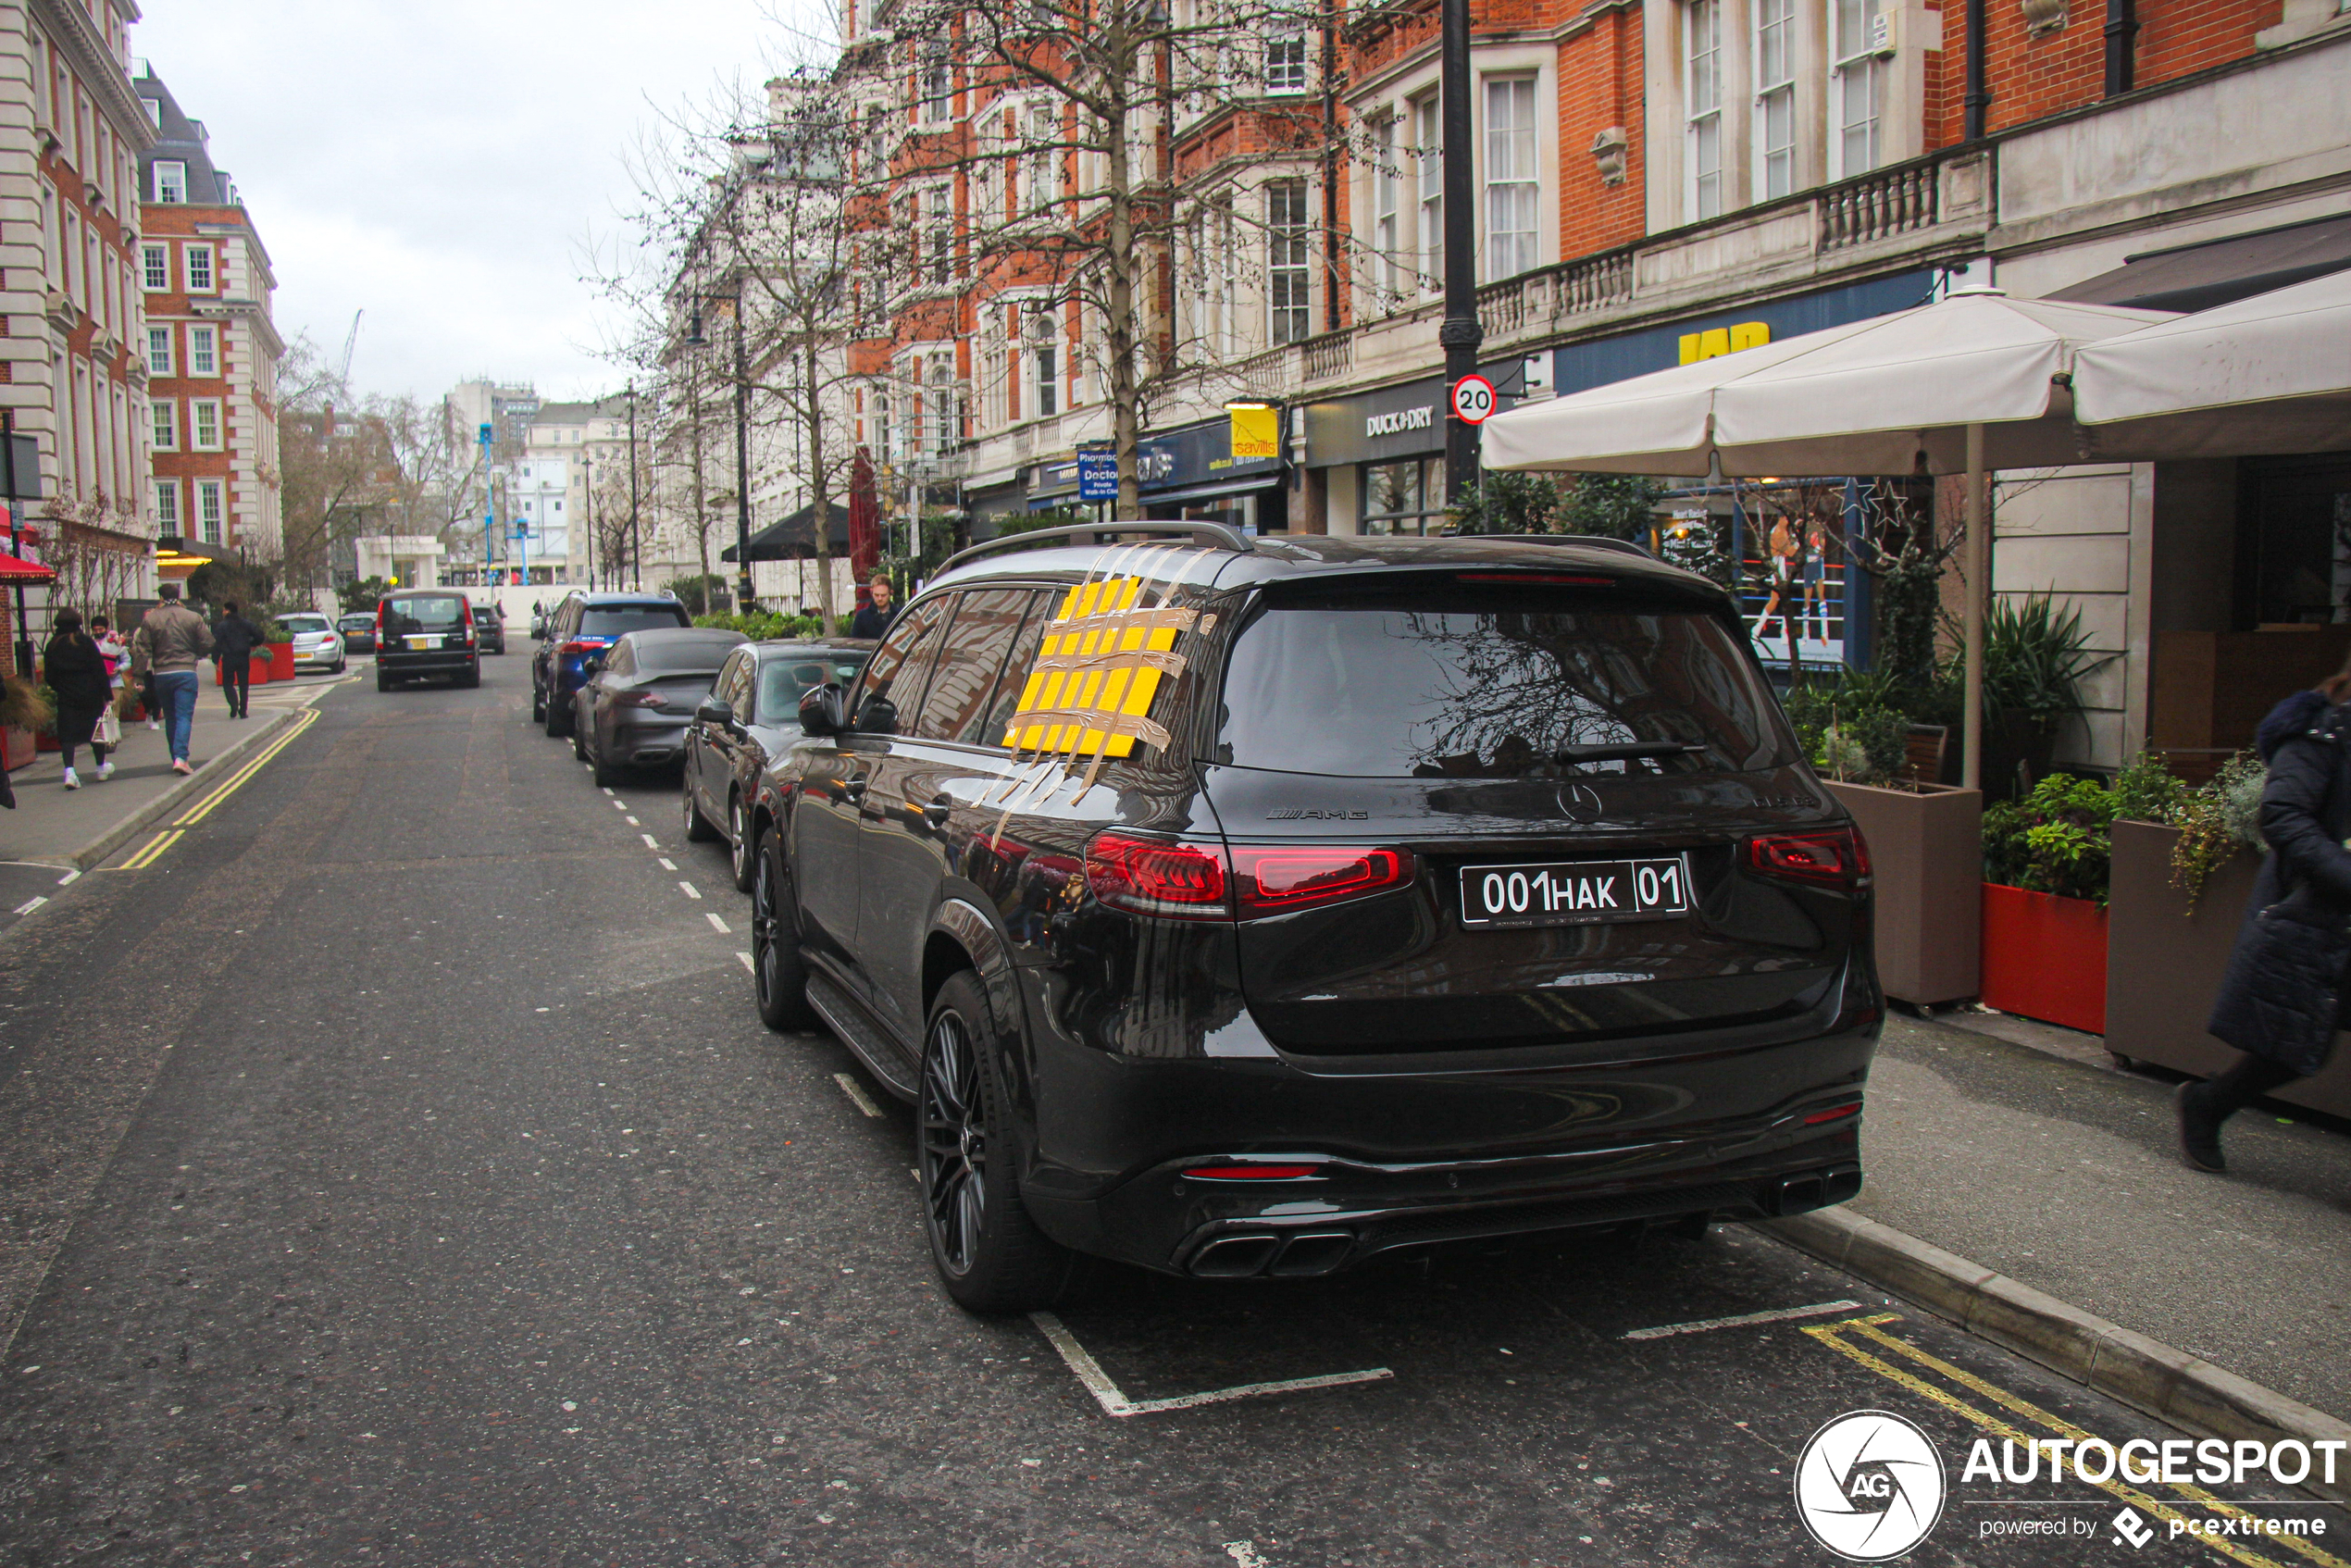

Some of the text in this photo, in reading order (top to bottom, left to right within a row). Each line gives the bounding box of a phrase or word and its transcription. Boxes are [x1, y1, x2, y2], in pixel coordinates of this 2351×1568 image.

[1460, 390, 1489, 410] 20
[1236, 439, 1276, 454] savills
[1079, 453, 1117, 463] Pharmac
[1300, 808, 1369, 820] AMG
